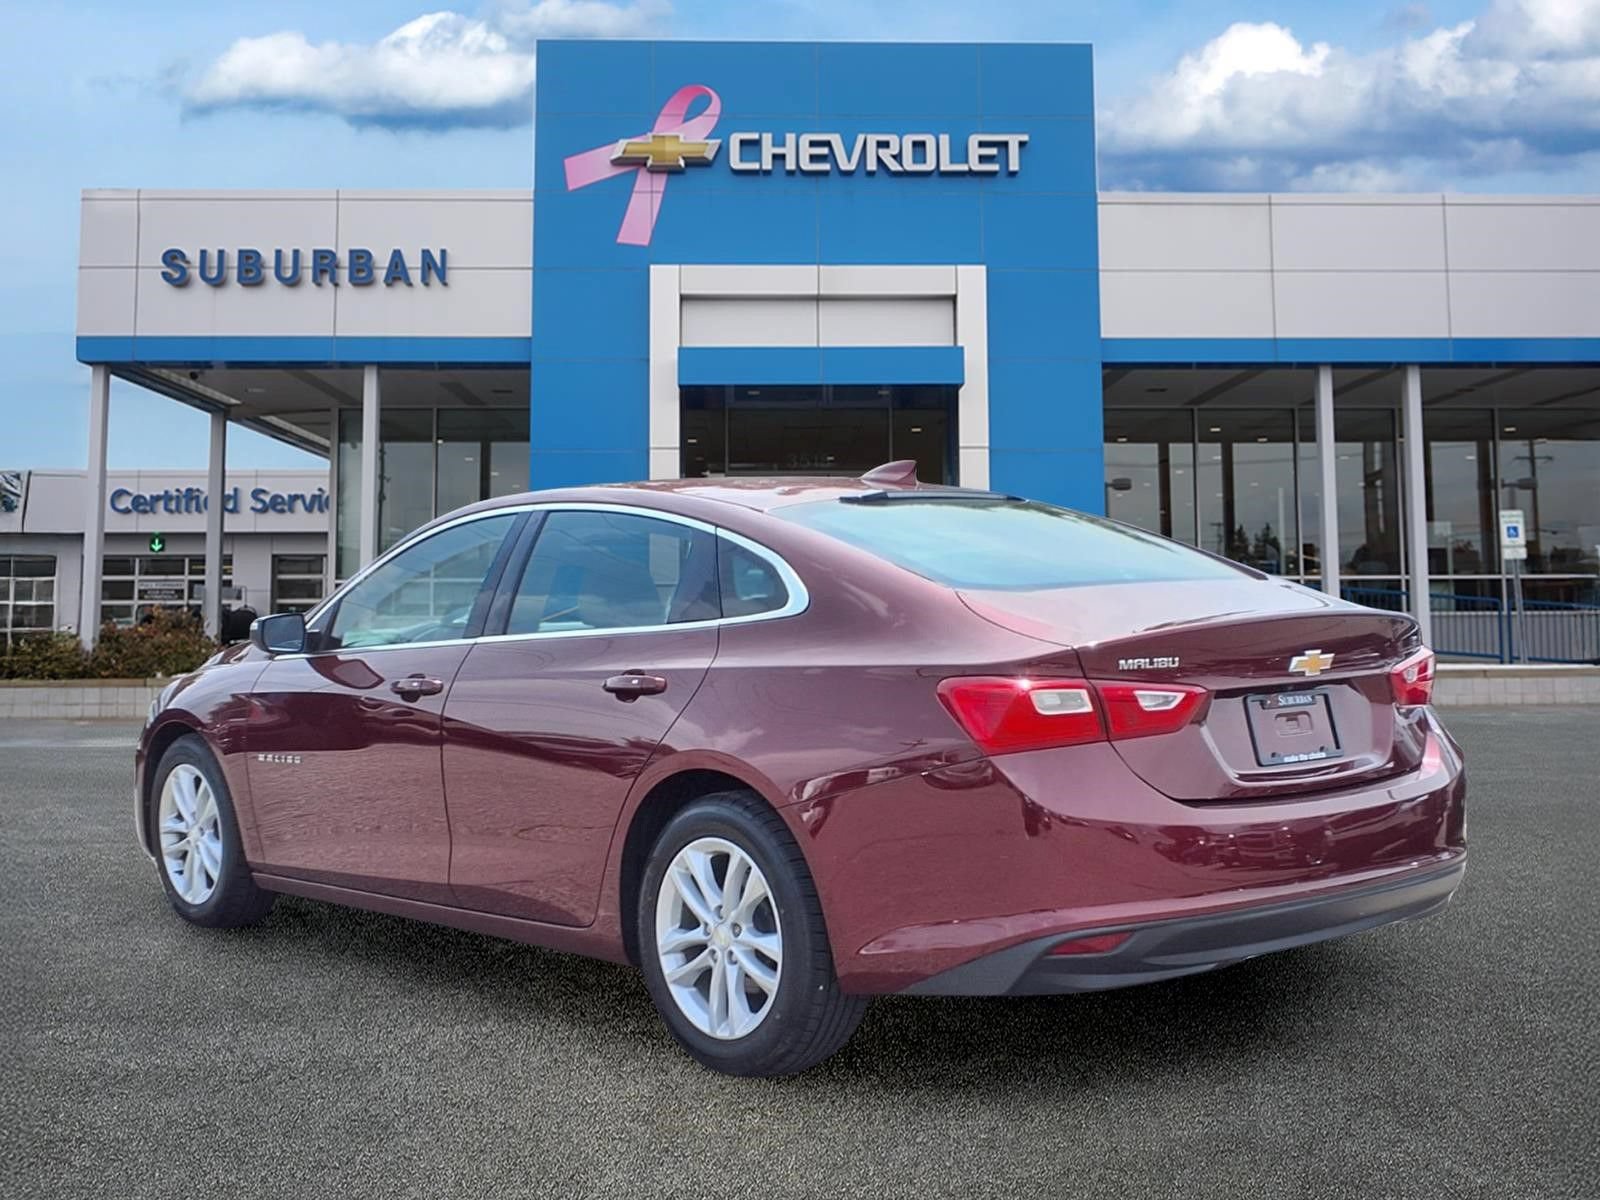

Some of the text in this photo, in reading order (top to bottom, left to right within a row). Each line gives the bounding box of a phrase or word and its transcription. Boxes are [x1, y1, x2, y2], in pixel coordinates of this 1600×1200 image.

[728, 132, 1030, 174] CHEVROLET
[161, 248, 449, 286] SUBURBAN
[110, 487, 240, 515] Certifid
[1118, 656, 1180, 670] MALIBU
